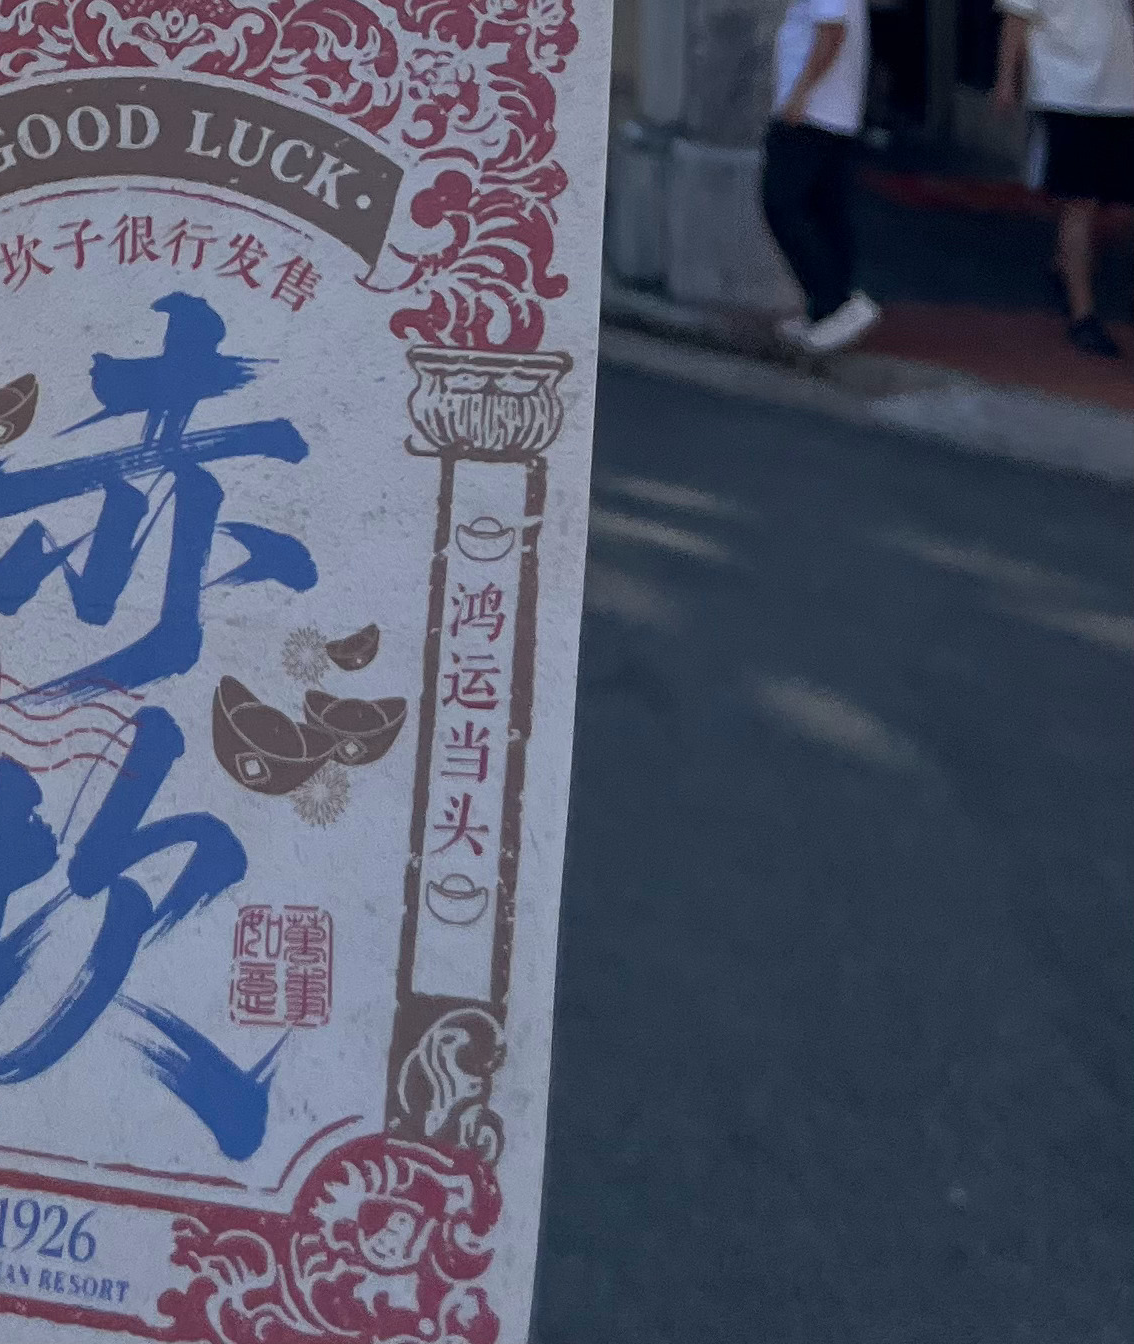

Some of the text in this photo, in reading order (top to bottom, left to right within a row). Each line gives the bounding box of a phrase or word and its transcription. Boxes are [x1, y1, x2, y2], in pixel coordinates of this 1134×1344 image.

[184, 109, 359, 210] LUCK
[430, 581, 506, 856] 鸿运当头
[38, 1267, 131, 1305] RESORT
